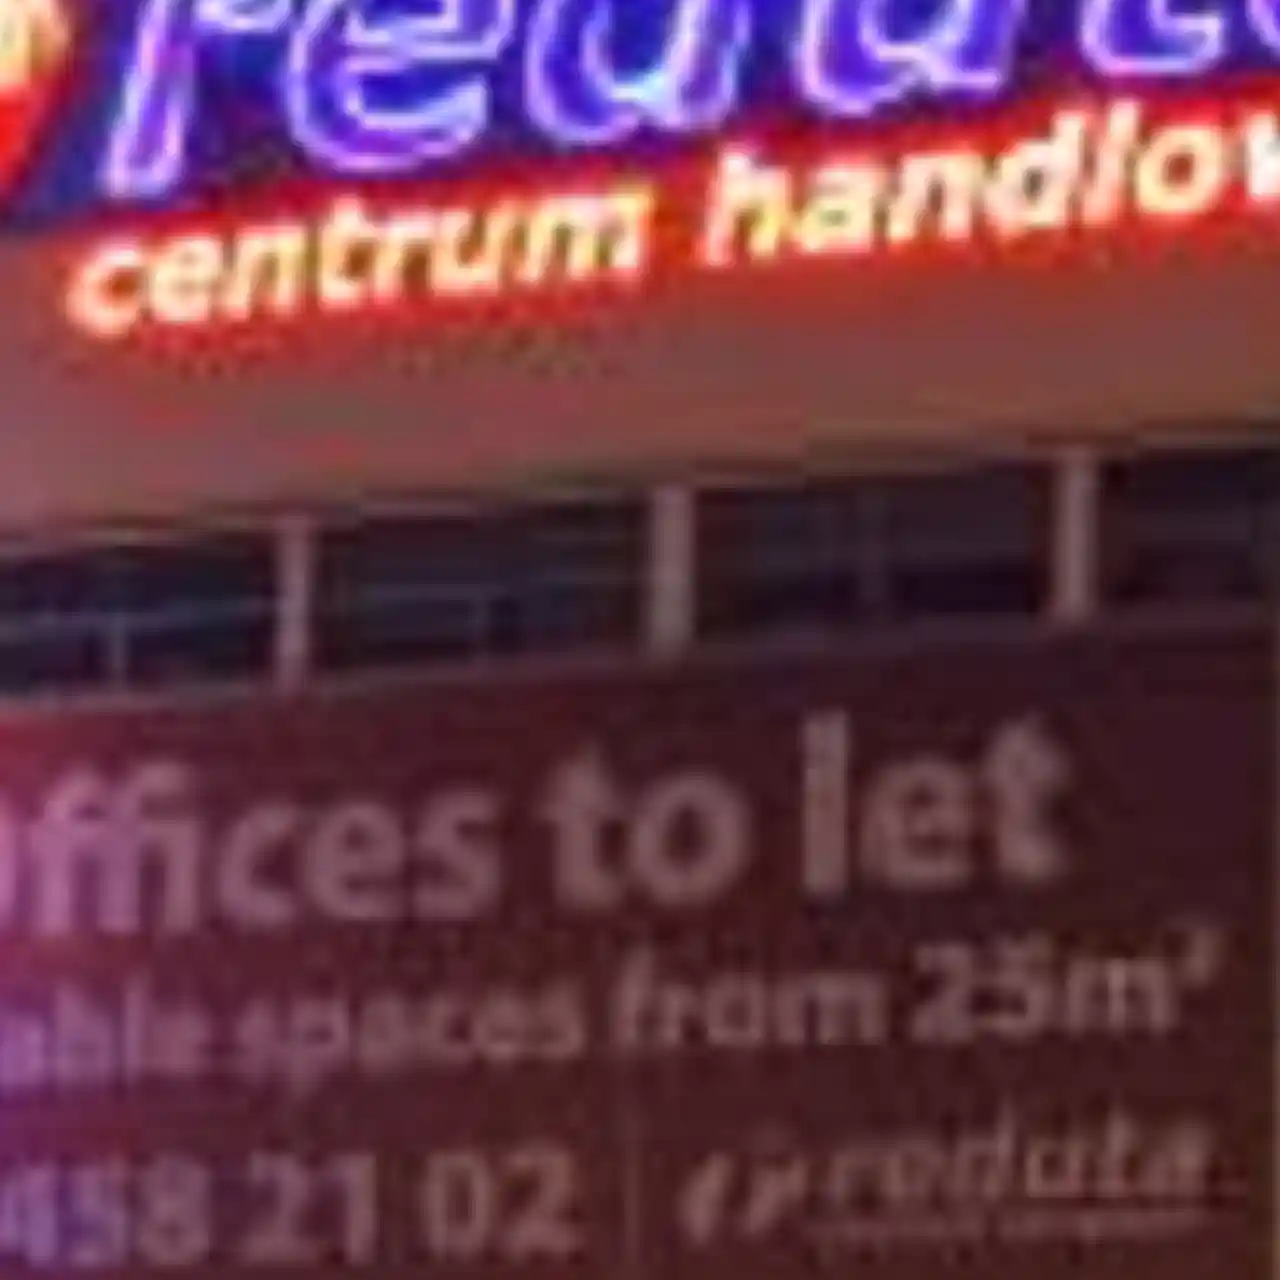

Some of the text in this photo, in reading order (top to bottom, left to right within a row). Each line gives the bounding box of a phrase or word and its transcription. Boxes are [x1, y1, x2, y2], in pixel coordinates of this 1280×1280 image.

[65, 188, 652, 338] centrum
[0, 708, 1070, 936] ffices to let
[615, 945, 890, 1050] from
[243, 1148, 378, 1266] 21
[420, 1138, 578, 1260] 02
